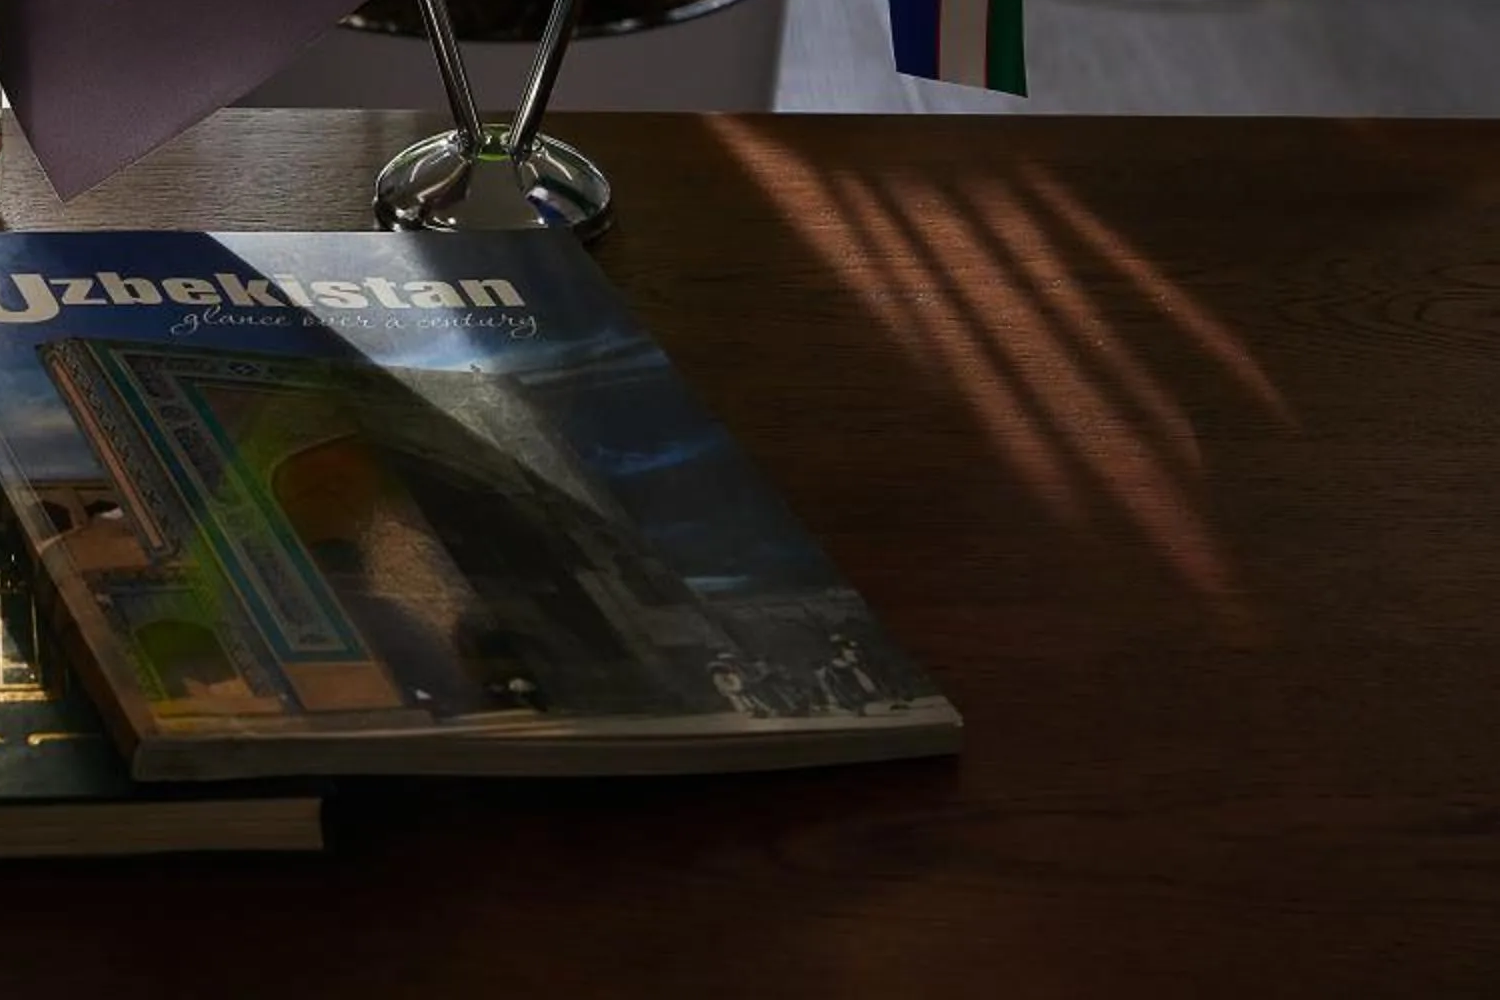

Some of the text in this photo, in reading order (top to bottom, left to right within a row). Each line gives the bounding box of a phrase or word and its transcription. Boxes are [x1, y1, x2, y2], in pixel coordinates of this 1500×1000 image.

[169, 303, 292, 337] glance
[385, 311, 405, 330] a
[417, 311, 539, 339] century
